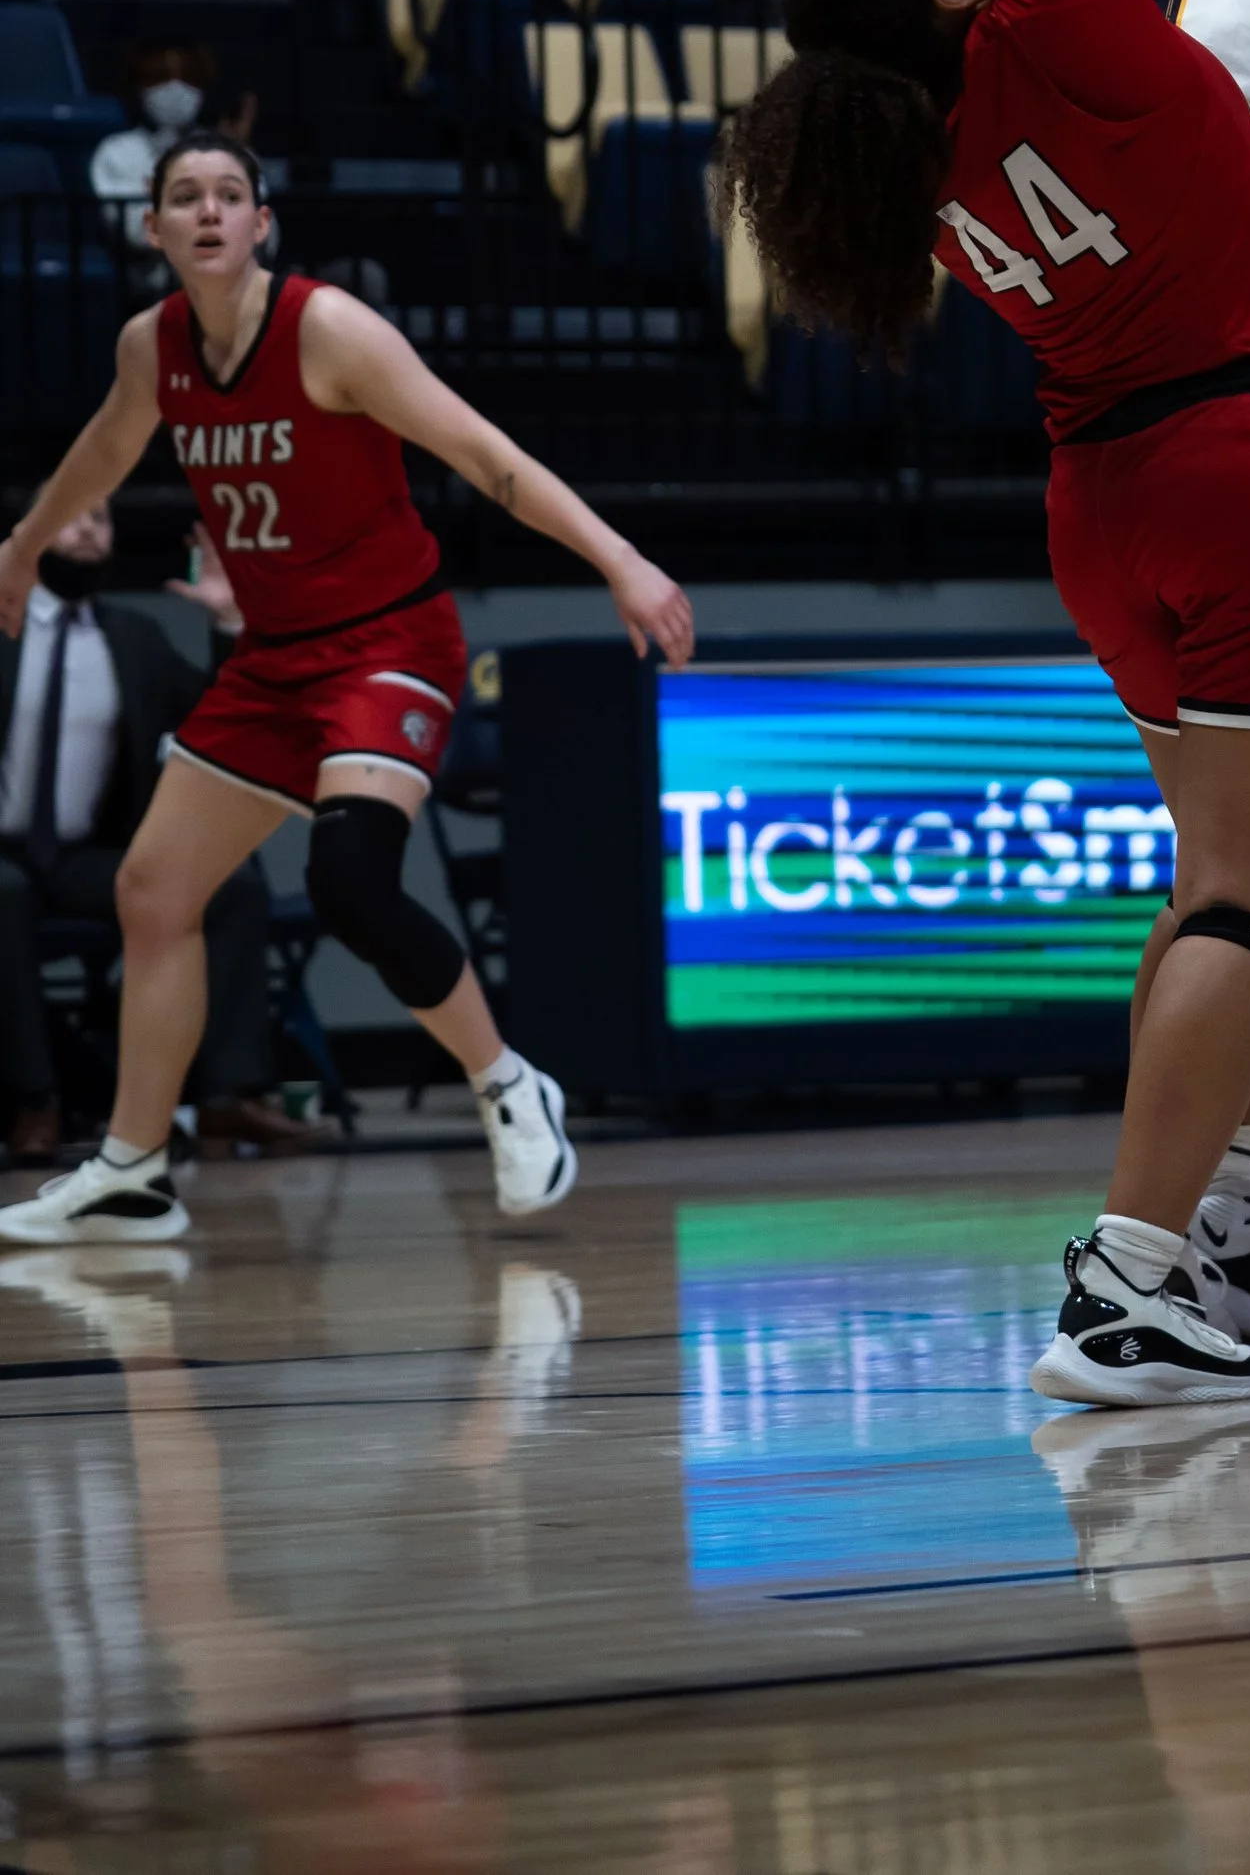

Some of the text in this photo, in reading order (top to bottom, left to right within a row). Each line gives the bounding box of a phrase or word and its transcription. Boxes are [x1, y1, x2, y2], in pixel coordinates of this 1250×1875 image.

[935, 139, 1131, 308] 44
[172, 418, 294, 467] SAINTS
[210, 481, 293, 551] 22
